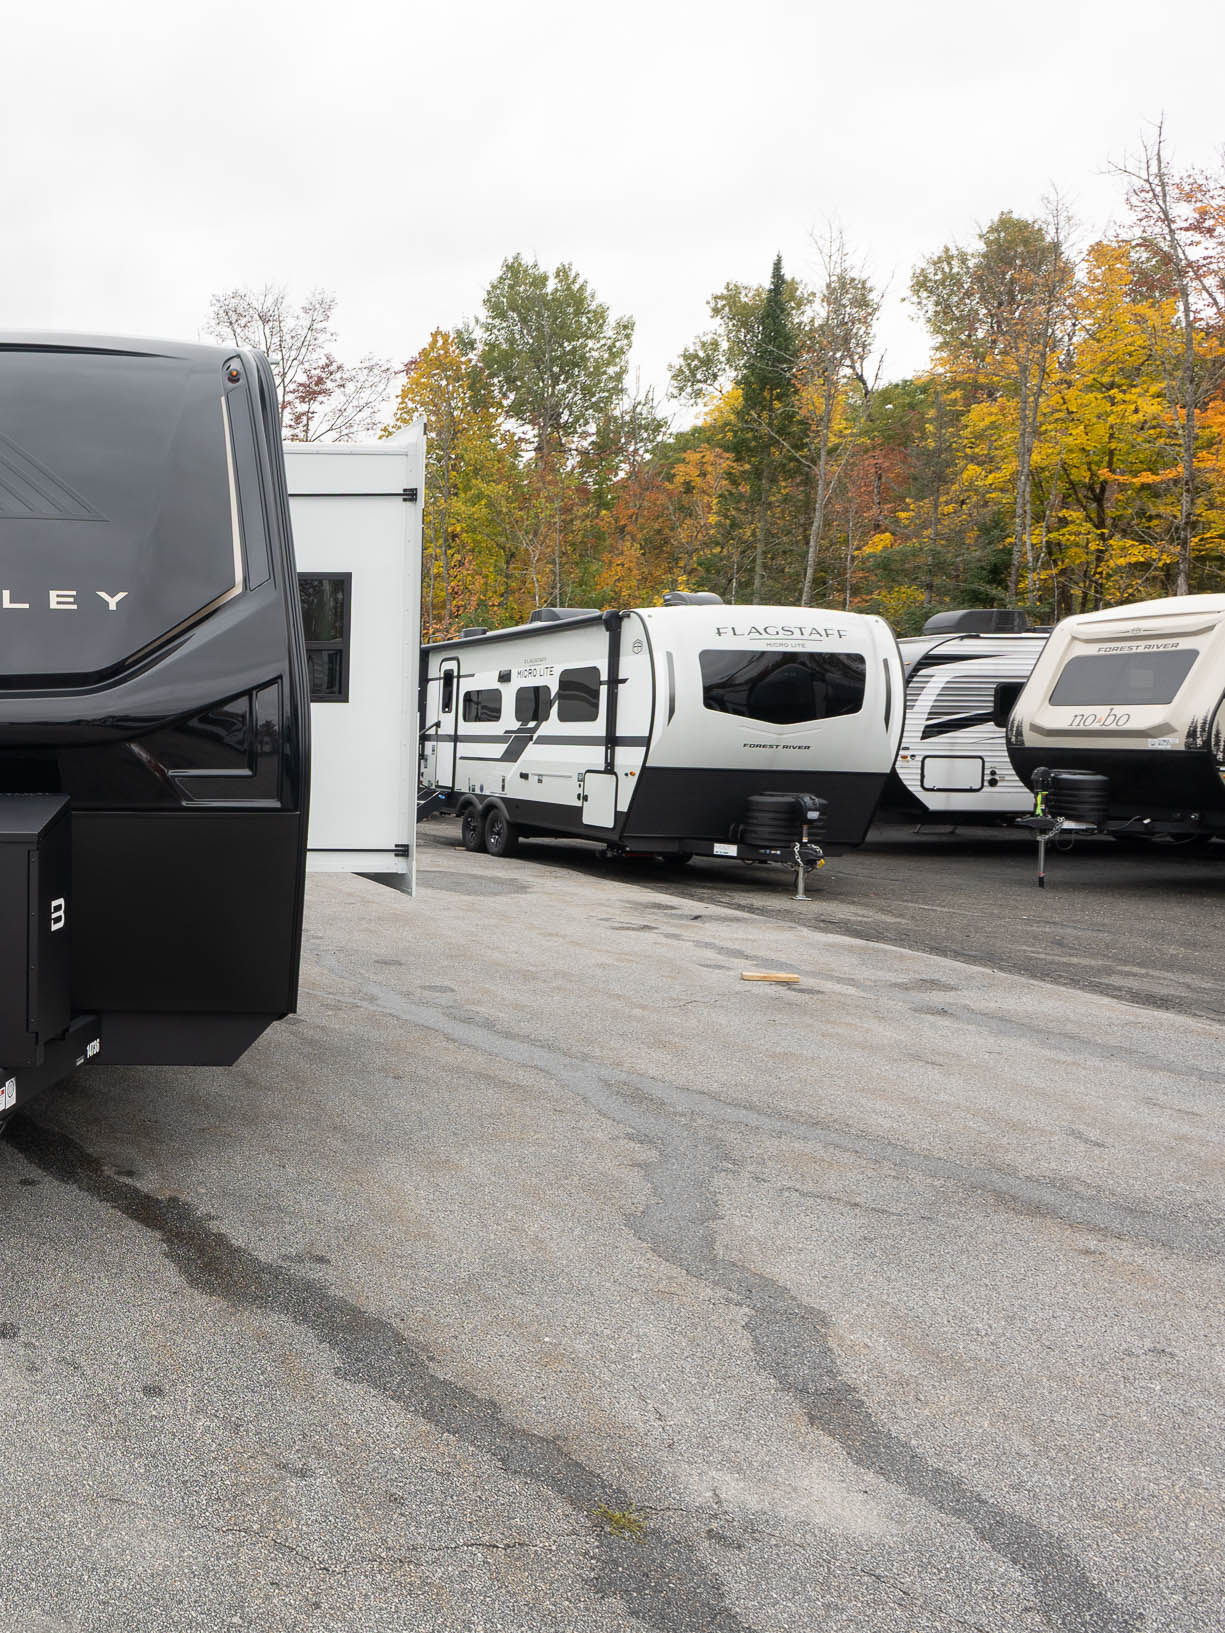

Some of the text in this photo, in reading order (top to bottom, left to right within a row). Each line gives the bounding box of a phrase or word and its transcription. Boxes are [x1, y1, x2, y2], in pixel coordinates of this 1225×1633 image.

[715, 625, 848, 639] FLAGSTAFF
[1097, 642, 1180, 653] FOREST RIVER
[517, 666, 554, 678] MICRO LITE
